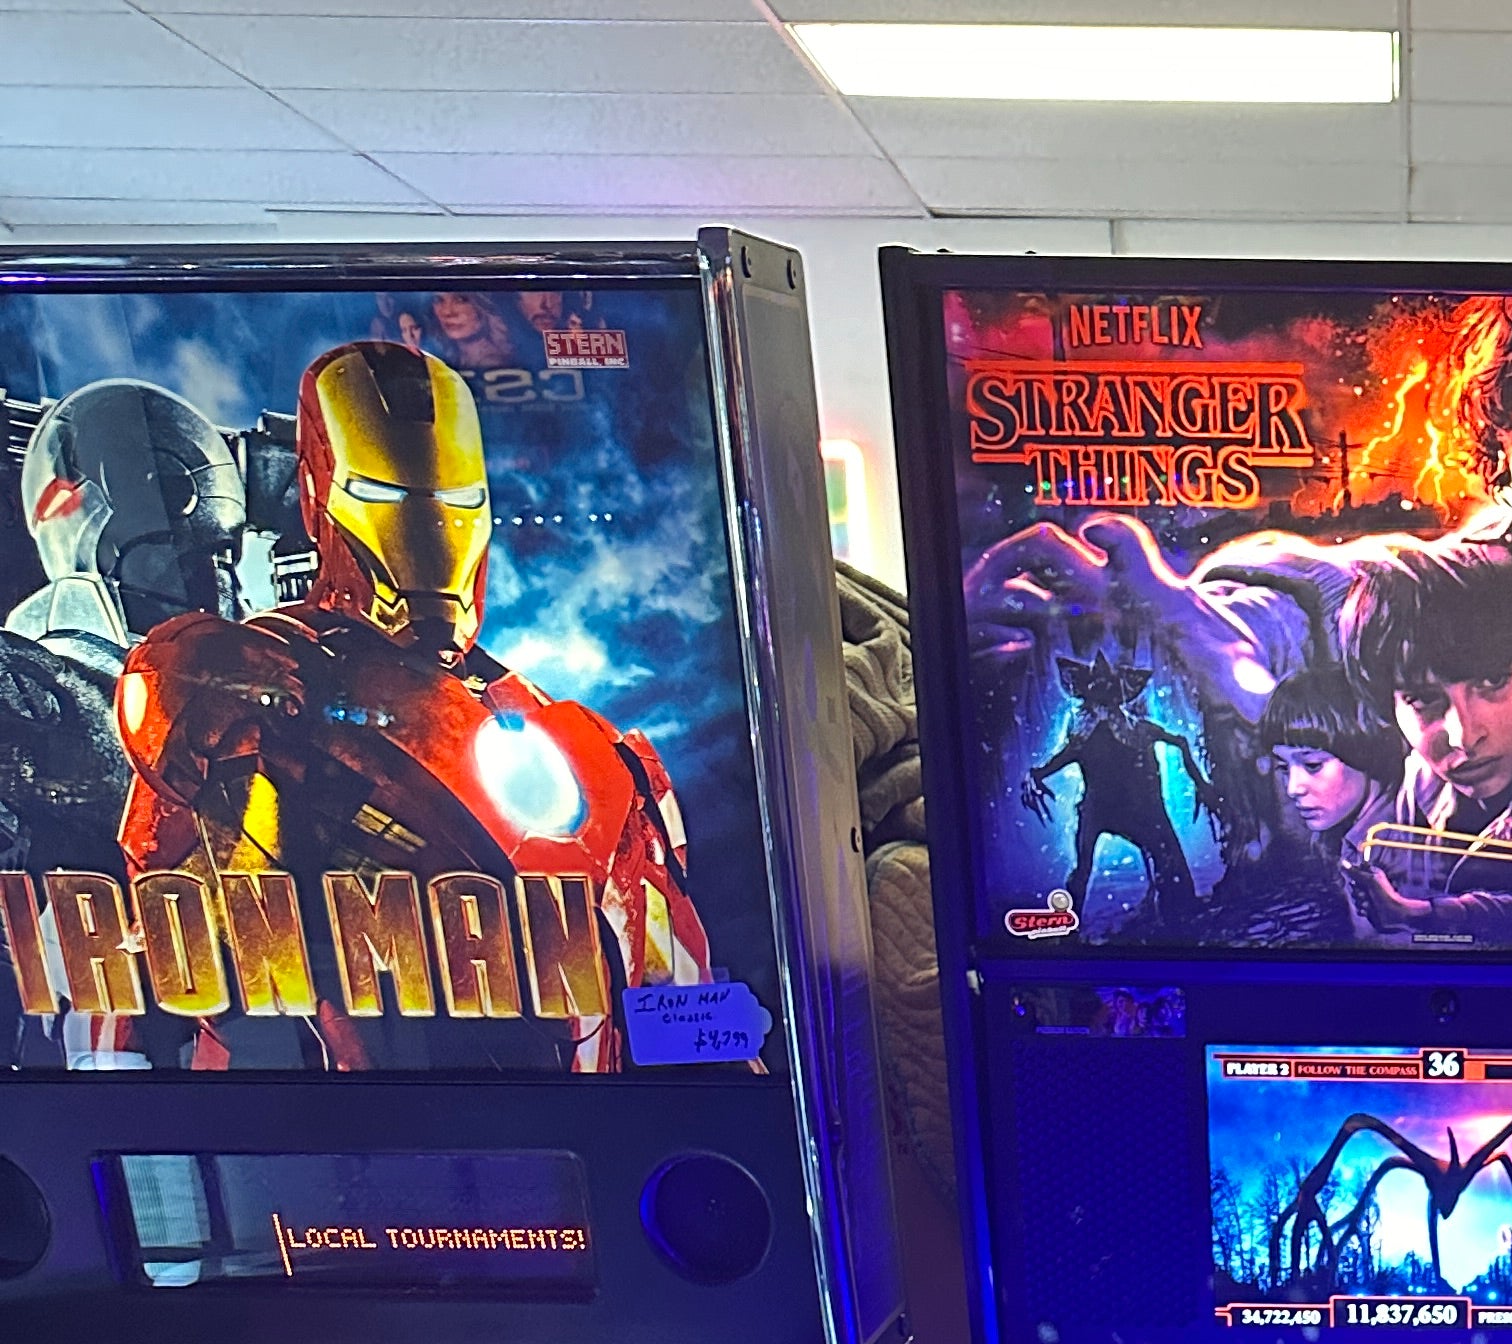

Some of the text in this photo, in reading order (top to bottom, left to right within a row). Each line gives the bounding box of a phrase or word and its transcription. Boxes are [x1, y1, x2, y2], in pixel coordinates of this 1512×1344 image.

[1069, 304, 1204, 349] NETFLIX
[547, 333, 625, 355] STERN
[966, 368, 1315, 453] STRANGER
[1024, 443, 1261, 509] THINGS
[1014, 915, 1069, 930] Stern
[0, 870, 610, 1018] IRON MAN
[1226, 1062, 1290, 1076] PLAYER 2
[1297, 1065, 1418, 1076] FOLLOW THE COMPASS
[1427, 1051, 1460, 1078] 36
[285, 1227, 587, 1251] LOCAL TOURNAMENTS!
[1241, 1309, 1322, 1326] 34,722,450
[1346, 1303, 1458, 1326] 11,837,650
